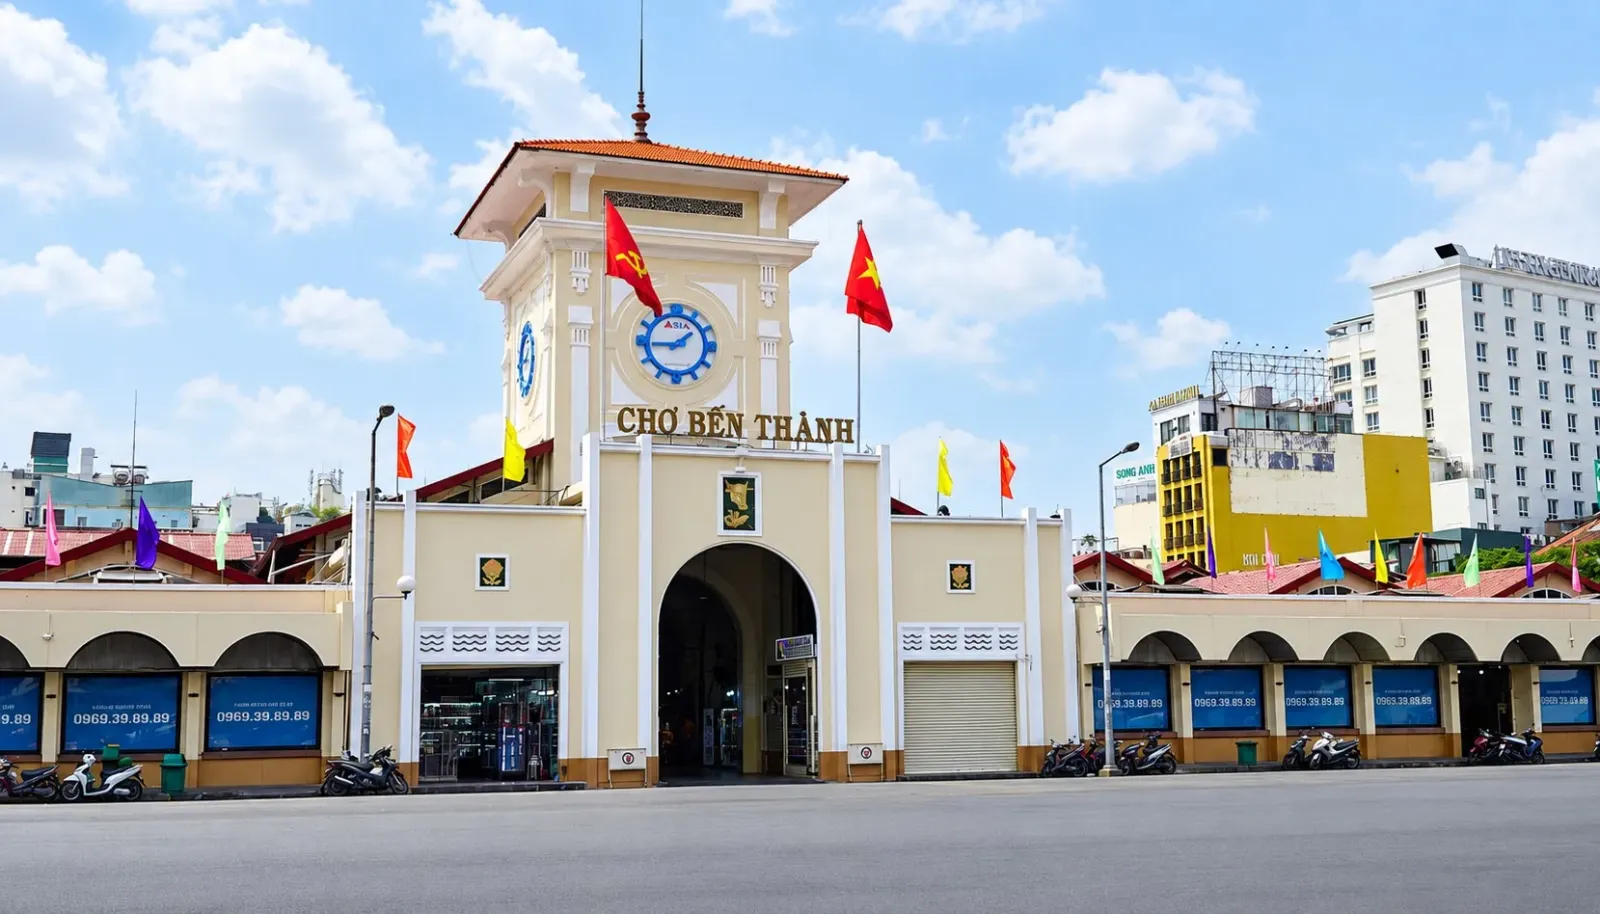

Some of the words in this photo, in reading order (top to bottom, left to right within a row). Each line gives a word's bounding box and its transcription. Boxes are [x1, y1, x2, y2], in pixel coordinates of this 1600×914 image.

[664, 321, 690, 330] ASIA
[687, 404, 744, 439] BẾN
[1116, 467, 1136, 479] SONG
[1138, 463, 1155, 475] ANH
[1194, 698, 1257, 707] 0969.39.89.89
[73, 713, 170, 725] 0969.39.89.89
[217, 711, 310, 722] 0969.39.89.89
